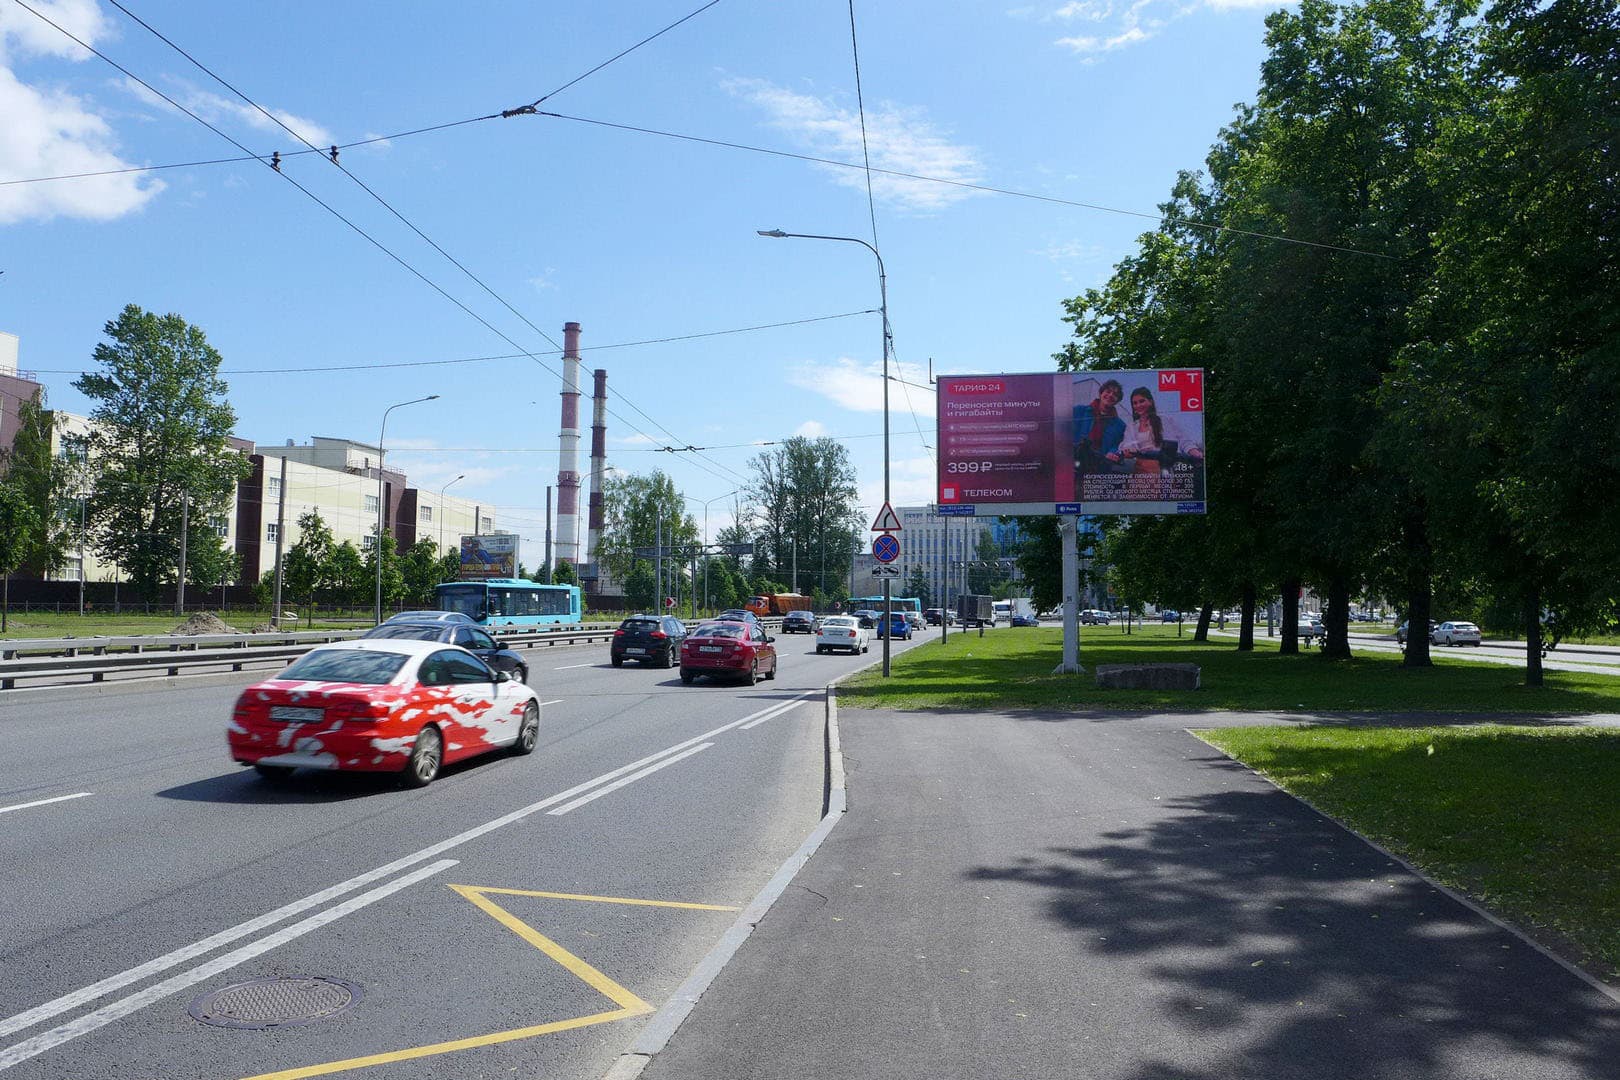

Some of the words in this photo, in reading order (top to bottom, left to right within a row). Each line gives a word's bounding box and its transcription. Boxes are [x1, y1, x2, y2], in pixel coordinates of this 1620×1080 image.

[953, 384, 987, 392] ТАРИФ
[988, 383, 1000, 391] 24
[947, 401, 1003, 410] Переносите
[954, 409, 1003, 417] гигабайты
[1174, 463, 1194, 471] 18+
[963, 488, 1013, 497] ТЕЛЕКОМ
